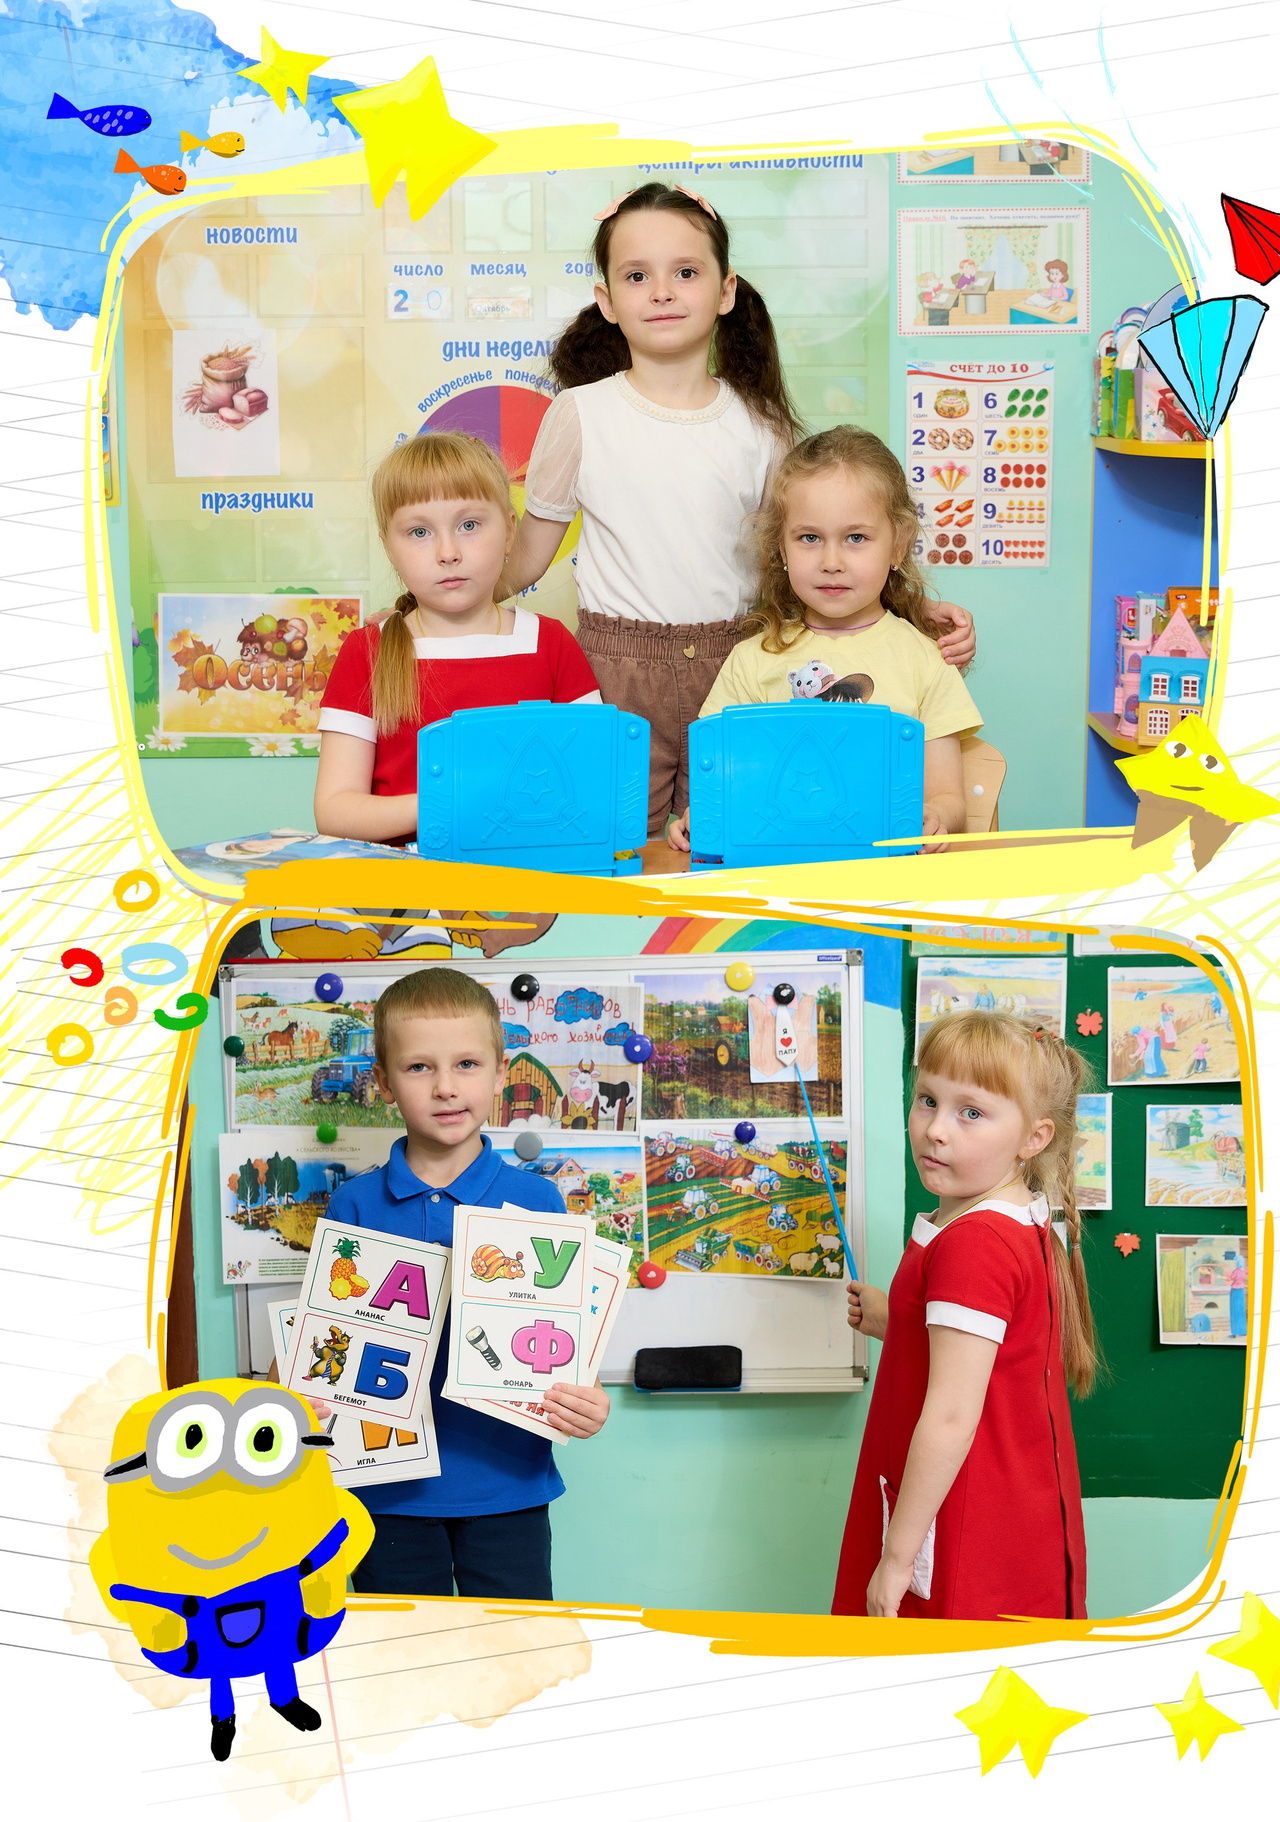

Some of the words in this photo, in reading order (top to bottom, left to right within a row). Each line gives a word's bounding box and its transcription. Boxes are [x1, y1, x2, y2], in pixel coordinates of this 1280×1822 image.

[206, 225, 298, 245] новости
[394, 264, 444, 276] число
[471, 263, 526, 278] месяц
[443, 341, 480, 362] дни
[949, 362, 983, 373] СЧЁТ
[987, 364, 1006, 374] ДО
[1010, 363, 1029, 373] 10
[418, 369, 493, 413] воскресенье
[913, 392, 923, 409] 1
[984, 392, 997, 410] 6
[912, 429, 926, 446] 2
[984, 430, 997, 446] 7
[912, 466, 925, 483] 3
[983, 467, 997, 484] 8
[201, 491, 314, 515] праздники
[983, 503, 997, 520] 9
[981, 539, 1004, 556] 10
[498, 997, 516, 1016] НЬ
[778, 1048, 797, 1056] ПАПУ
[530, 1237, 581, 1289] У
[369, 1260, 430, 1320] А
[509, 1292, 536, 1300] УЛИТКА
[355, 1310, 385, 1321] АНАНАС
[511, 1320, 575, 1374] Ф
[354, 1342, 411, 1400] Б
[503, 1380, 533, 1388] ФОНАРЬ
[334, 1394, 367, 1406] БЕГЕМОТ
[357, 1458, 376, 1466] ИГЛА
